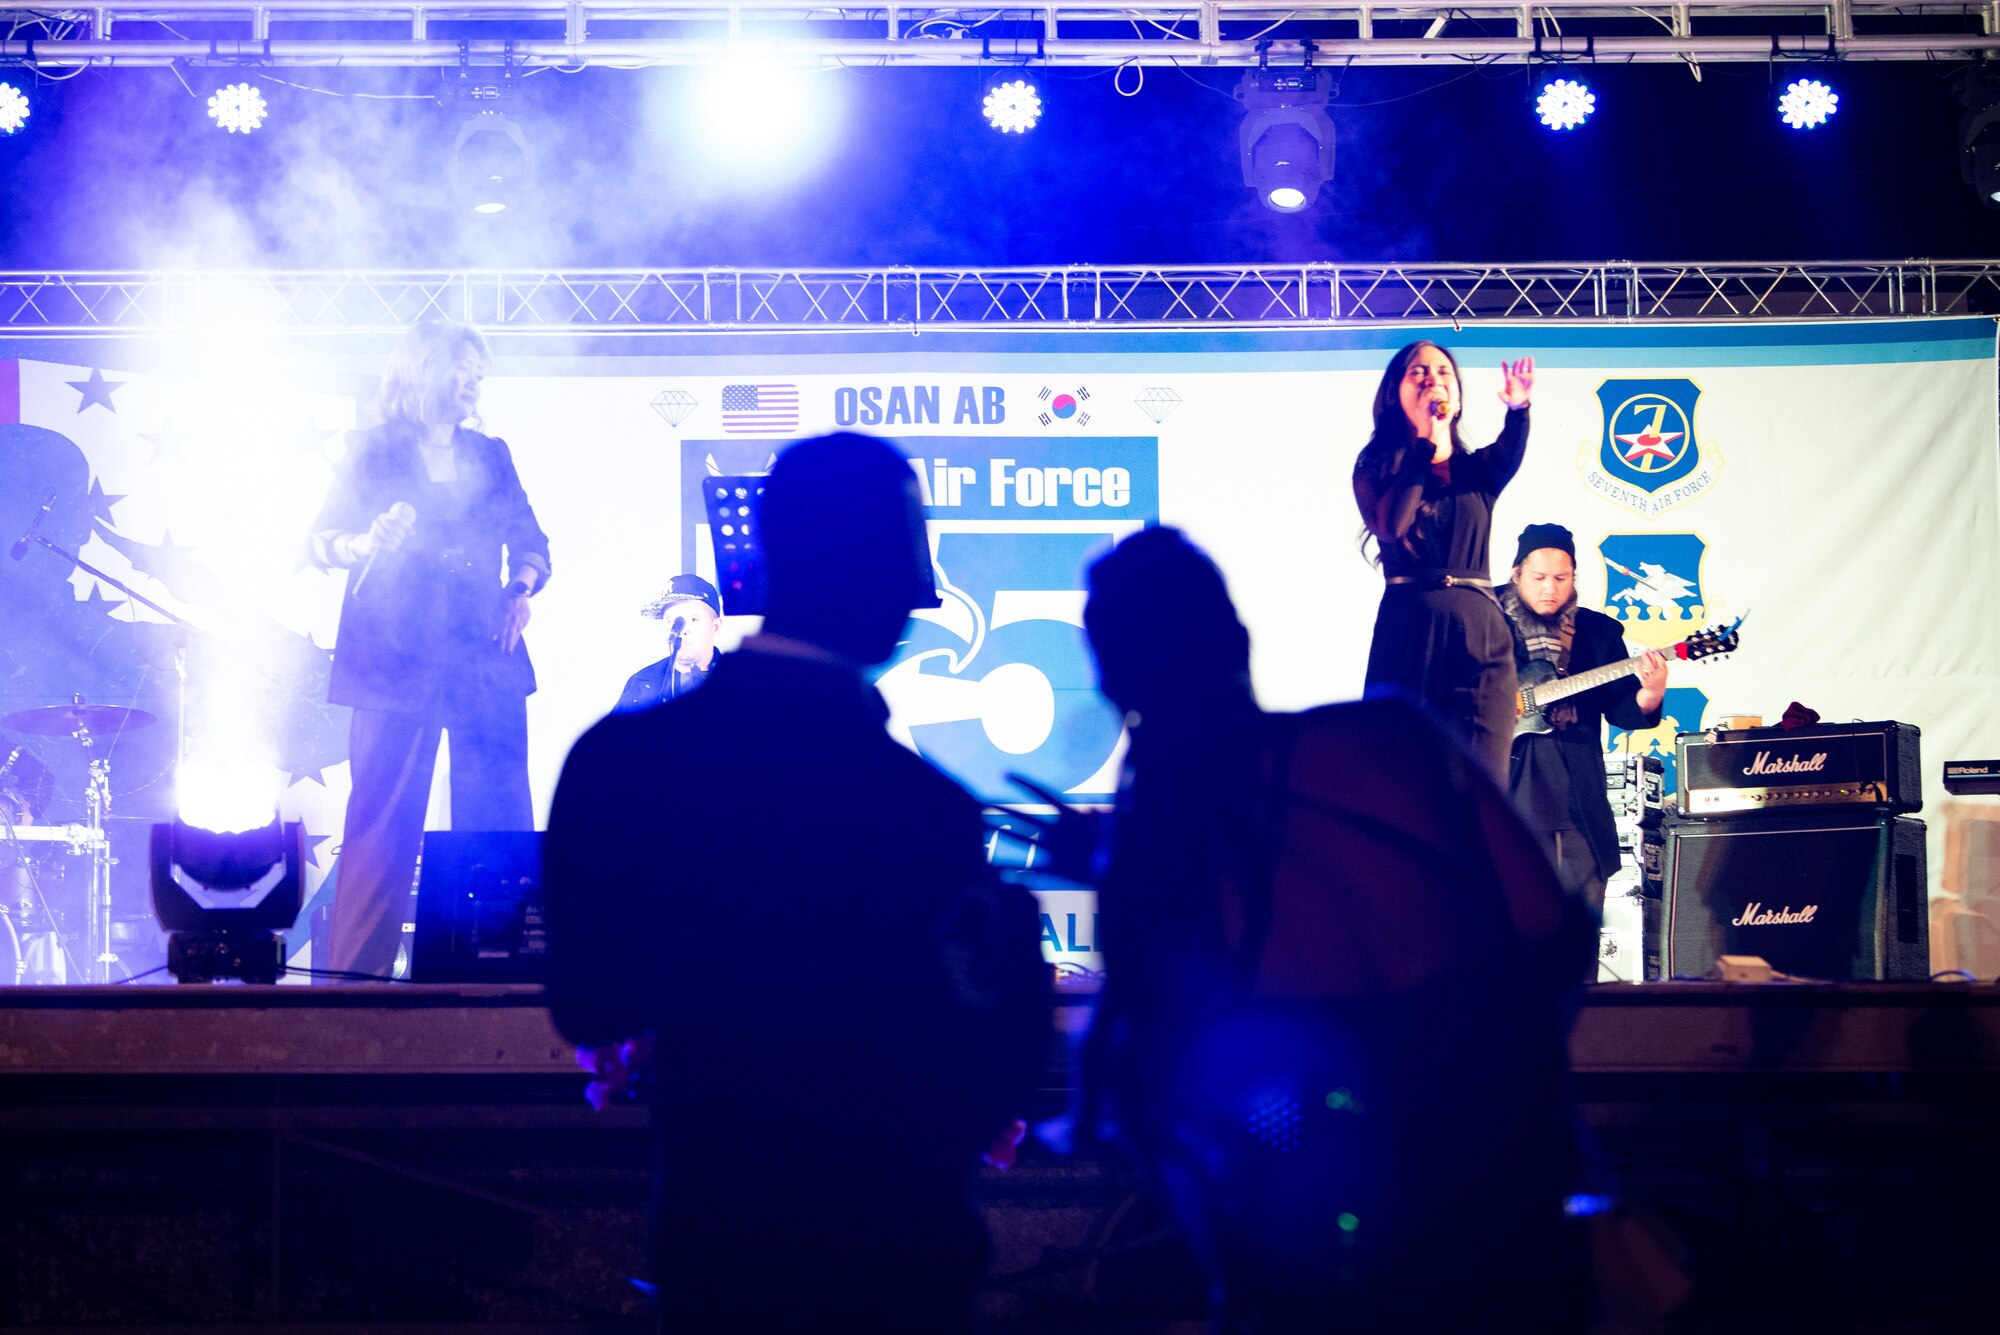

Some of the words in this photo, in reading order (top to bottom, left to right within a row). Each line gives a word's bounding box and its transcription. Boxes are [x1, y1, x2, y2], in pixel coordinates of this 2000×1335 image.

[834, 386, 940, 426] OSAN
[953, 385, 1006, 425] AB
[990, 458, 1131, 507] Force
[1587, 471, 1648, 512] SEVENTH
[1651, 494, 1673, 515] AIR
[1673, 471, 1711, 501] FORCE
[1743, 751, 1827, 776] Marshall
[1959, 766, 1988, 774] Roland
[1732, 902, 1818, 926] Marshall
